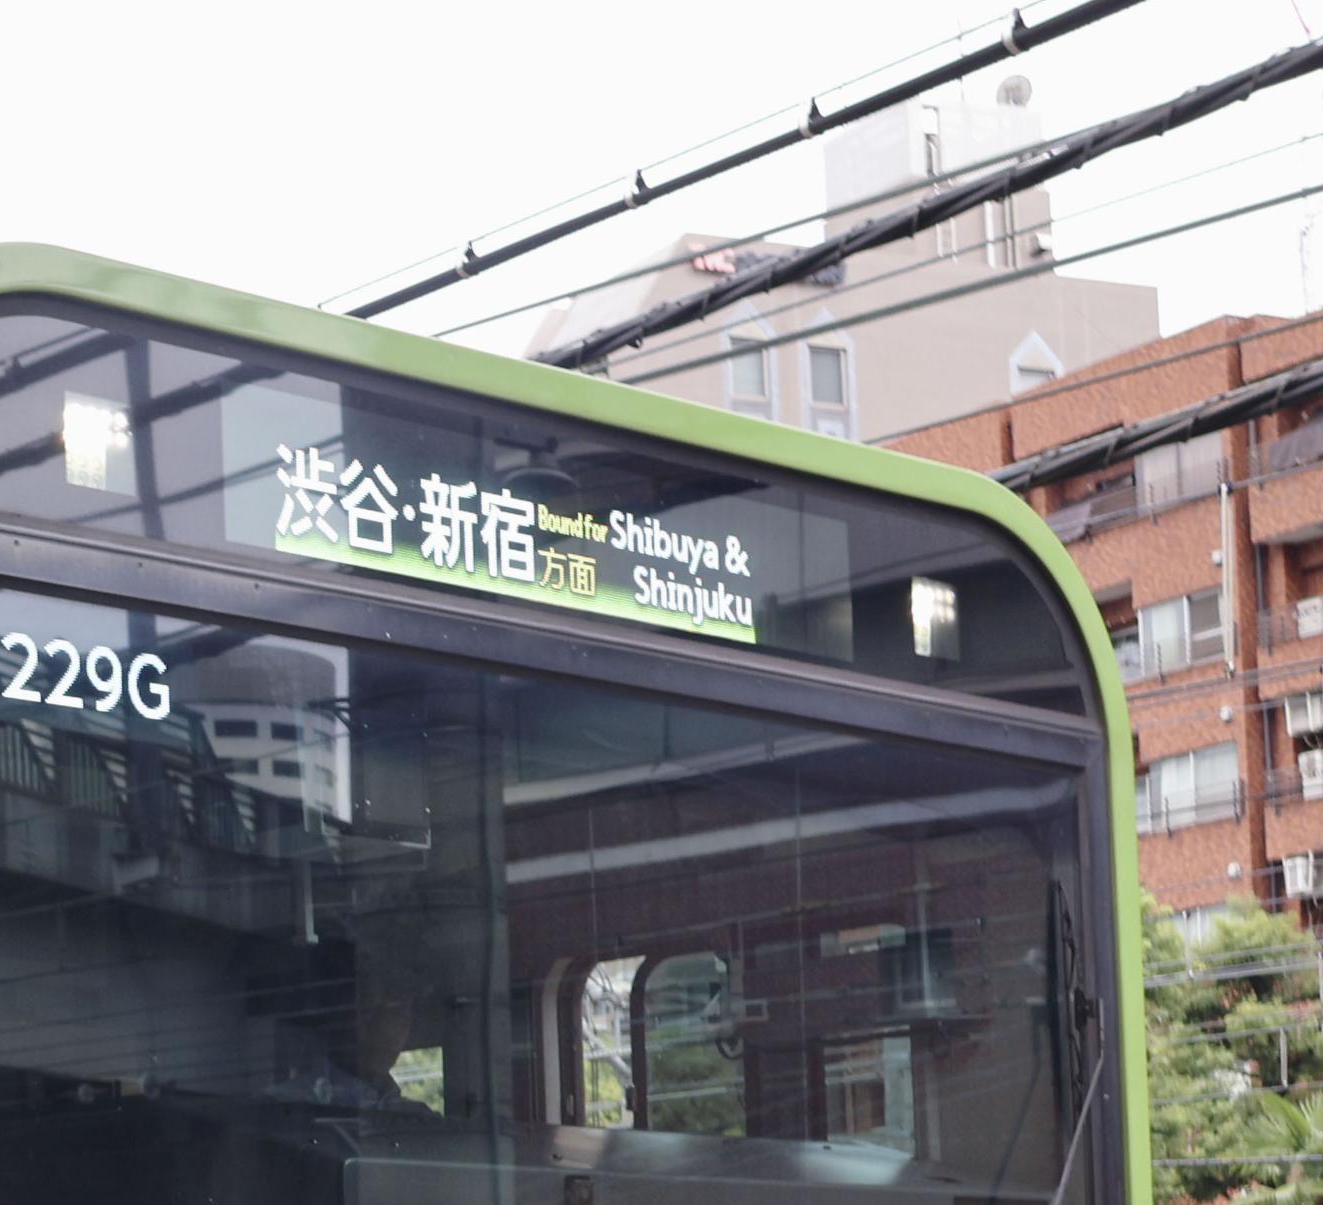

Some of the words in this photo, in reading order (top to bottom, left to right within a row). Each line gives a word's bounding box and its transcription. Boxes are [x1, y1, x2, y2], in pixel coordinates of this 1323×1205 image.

[276, 443, 535, 582] 渋谷・新宿
[538, 504, 583, 538] Bound
[584, 513, 608, 543] for
[610, 510, 719, 575] Shibuya
[725, 535, 750, 577] &
[538, 548, 596, 596] 方面
[633, 564, 753, 626] Shinjuku
